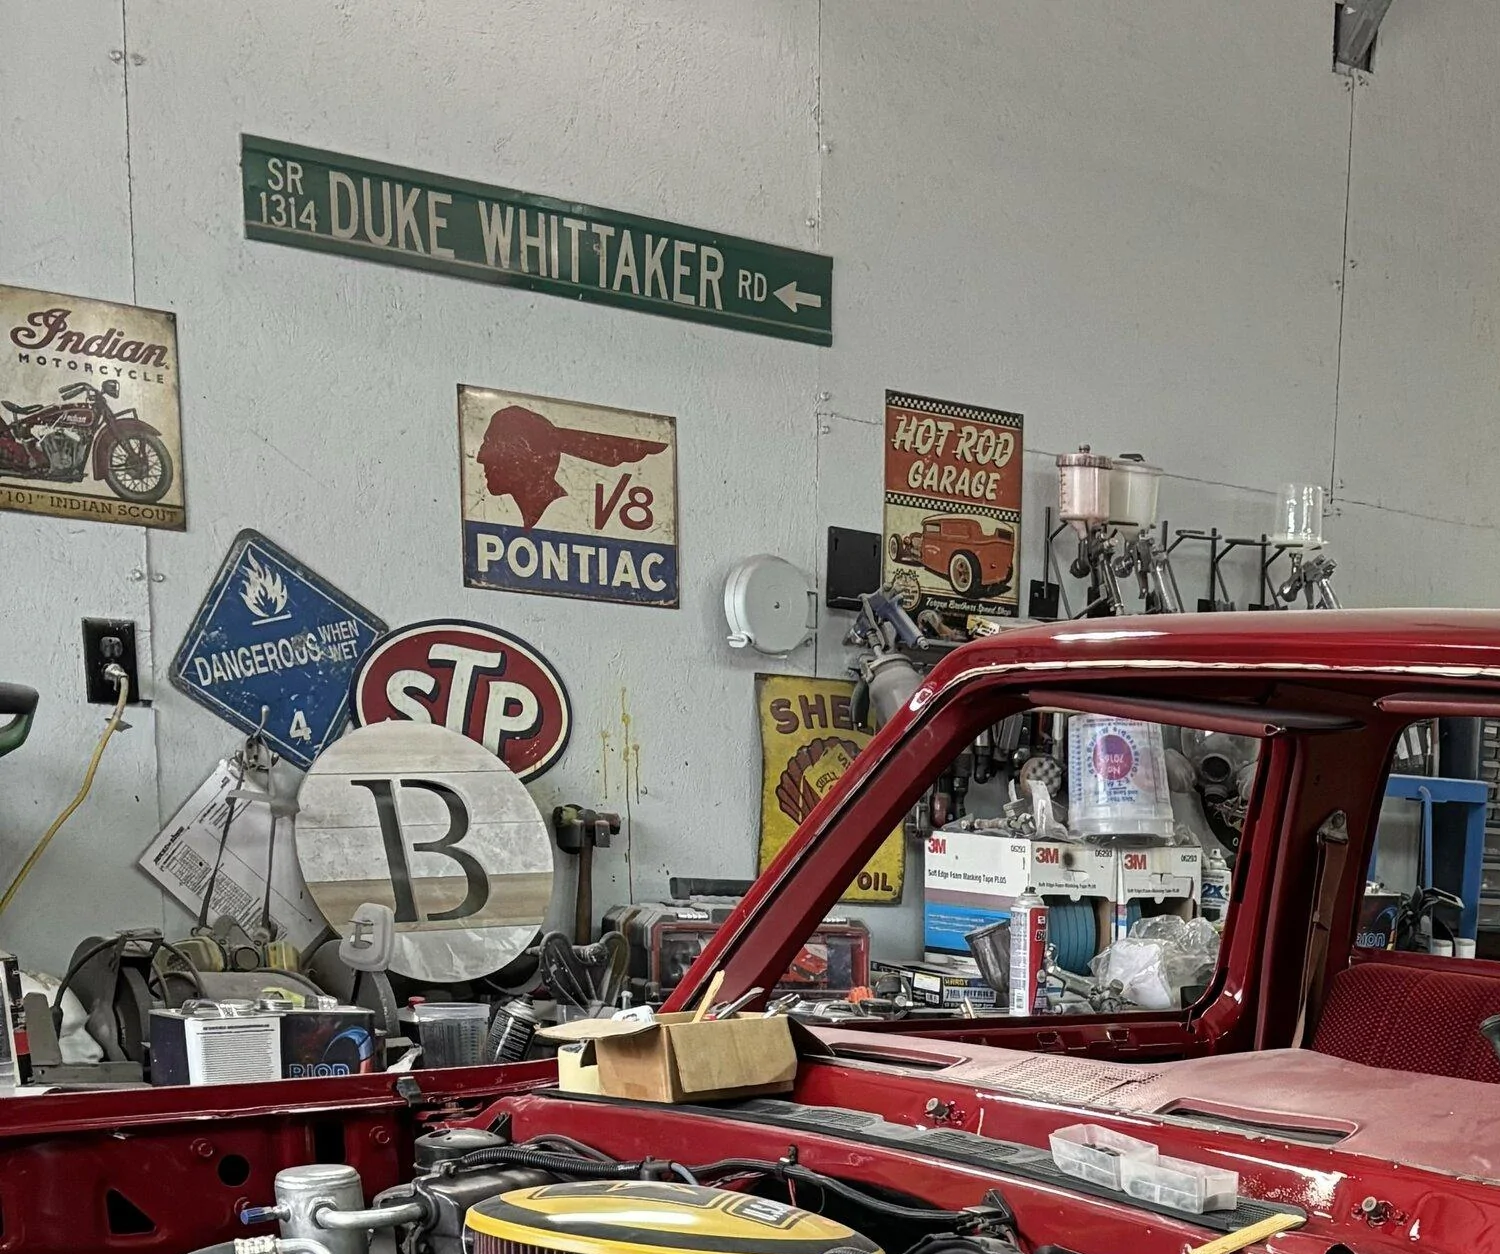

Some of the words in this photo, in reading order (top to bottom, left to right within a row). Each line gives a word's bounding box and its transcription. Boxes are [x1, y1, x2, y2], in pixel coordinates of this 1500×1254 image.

[267, 157, 303, 195] SR
[259, 191, 317, 232] 1314
[329, 170, 455, 259] DUKE
[478, 200, 723, 311] WHITTAKER
[738, 269, 767, 302] RD
[10, 308, 168, 367] Indian
[18, 353, 165, 384] MOTORCYCLE
[892, 415, 954, 457] HOT
[952, 425, 1014, 468] ROD
[908, 460, 1000, 500] GARAGE
[50, 496, 112, 514] INDIAN
[117, 505, 177, 522] SCOUT
[595, 473, 654, 531] V8
[477, 533, 667, 592] PONTIAC
[318, 619, 359, 645] WHEN
[326, 639, 358, 662] WET
[194, 633, 321, 687] DANGEROUS
[386, 643, 541, 757] STP
[770, 694, 855, 734] SHE
[289, 710, 312, 744] 4
[351, 778, 491, 922] B
[928, 838, 946, 854] 3M
[1036, 848, 1059, 864] 3M
[1124, 854, 1146, 870] 3M
[857, 871, 893, 892] OIL
[1201, 883, 1224, 899] 2X
